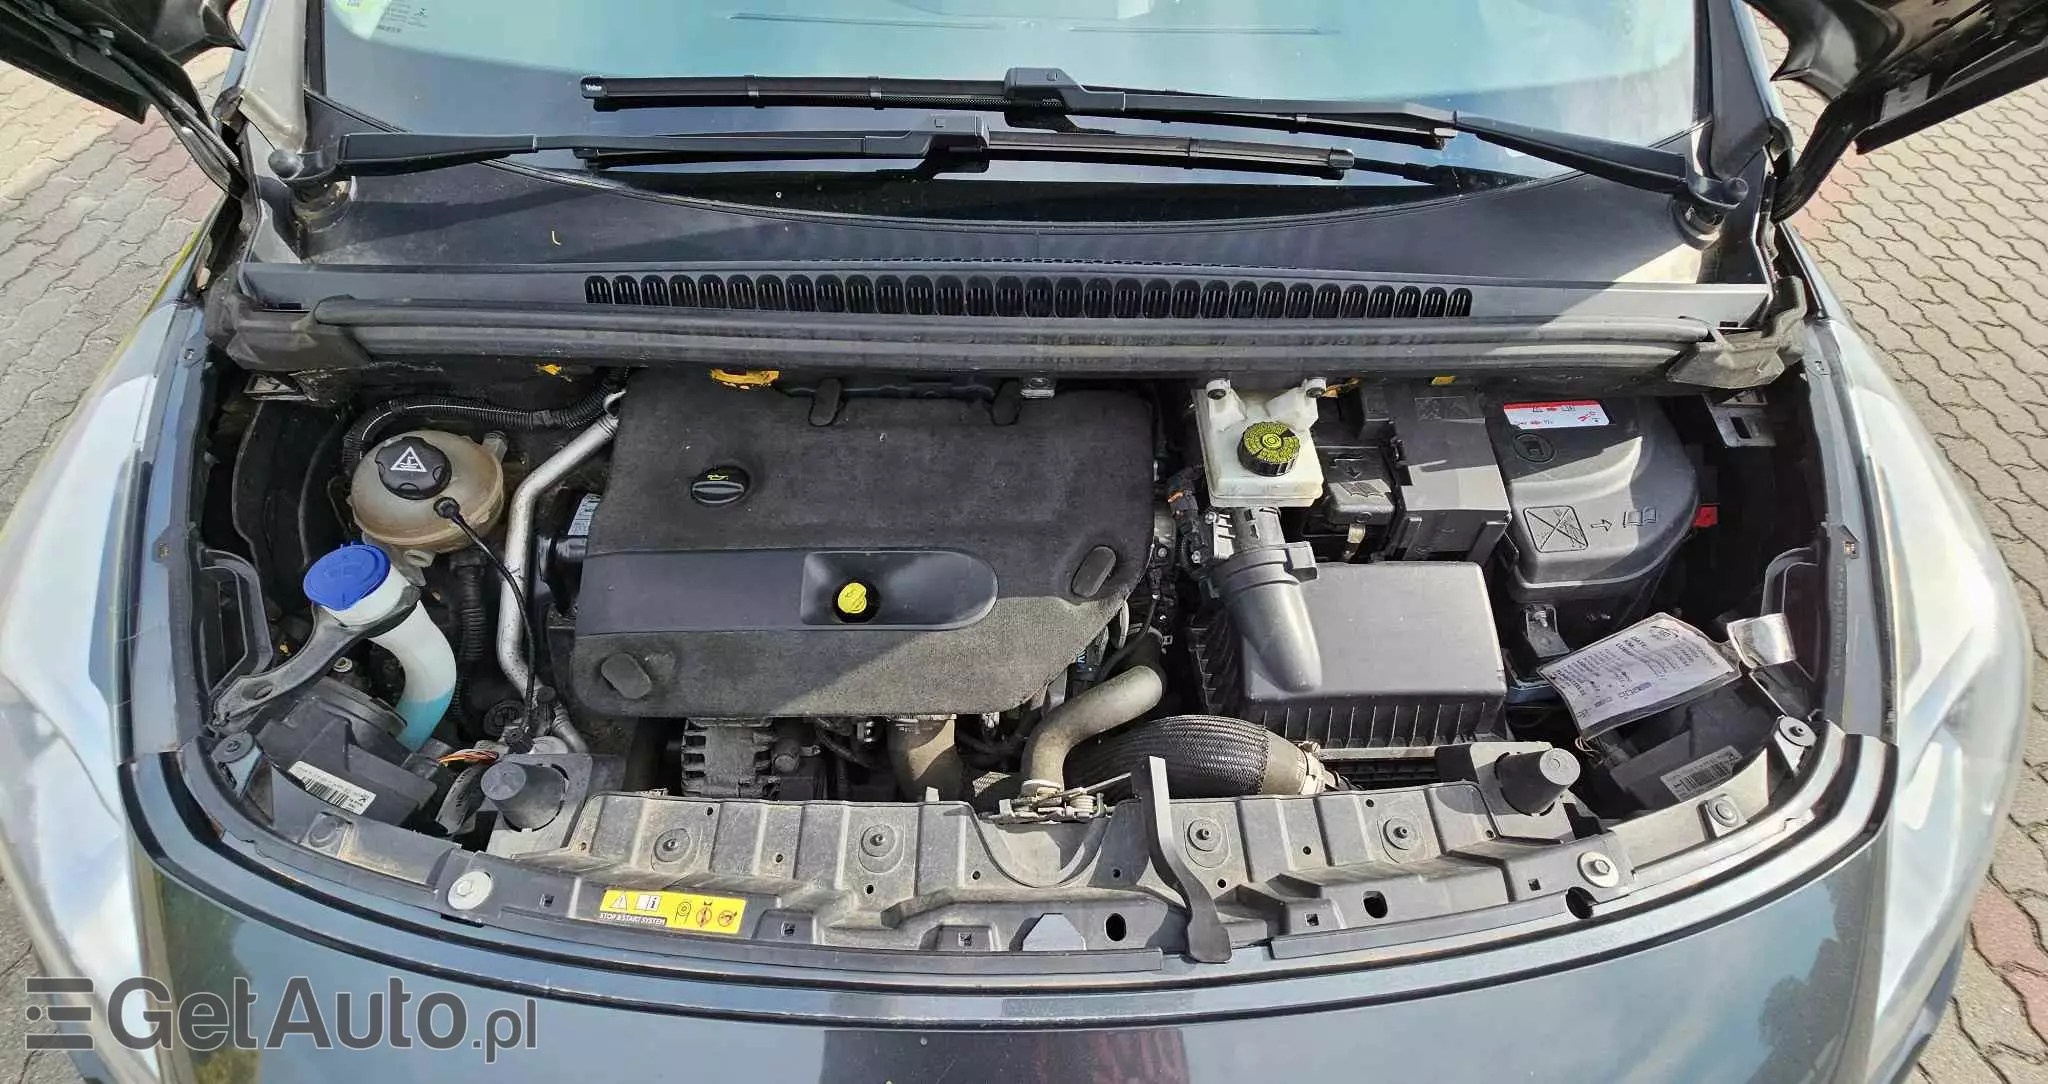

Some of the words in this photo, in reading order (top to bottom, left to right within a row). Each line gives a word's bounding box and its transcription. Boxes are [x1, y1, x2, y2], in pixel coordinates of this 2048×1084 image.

[600, 912, 616, 921] STOP
[622, 915, 640, 923] START
[641, 917, 666, 926] SYSTEM
